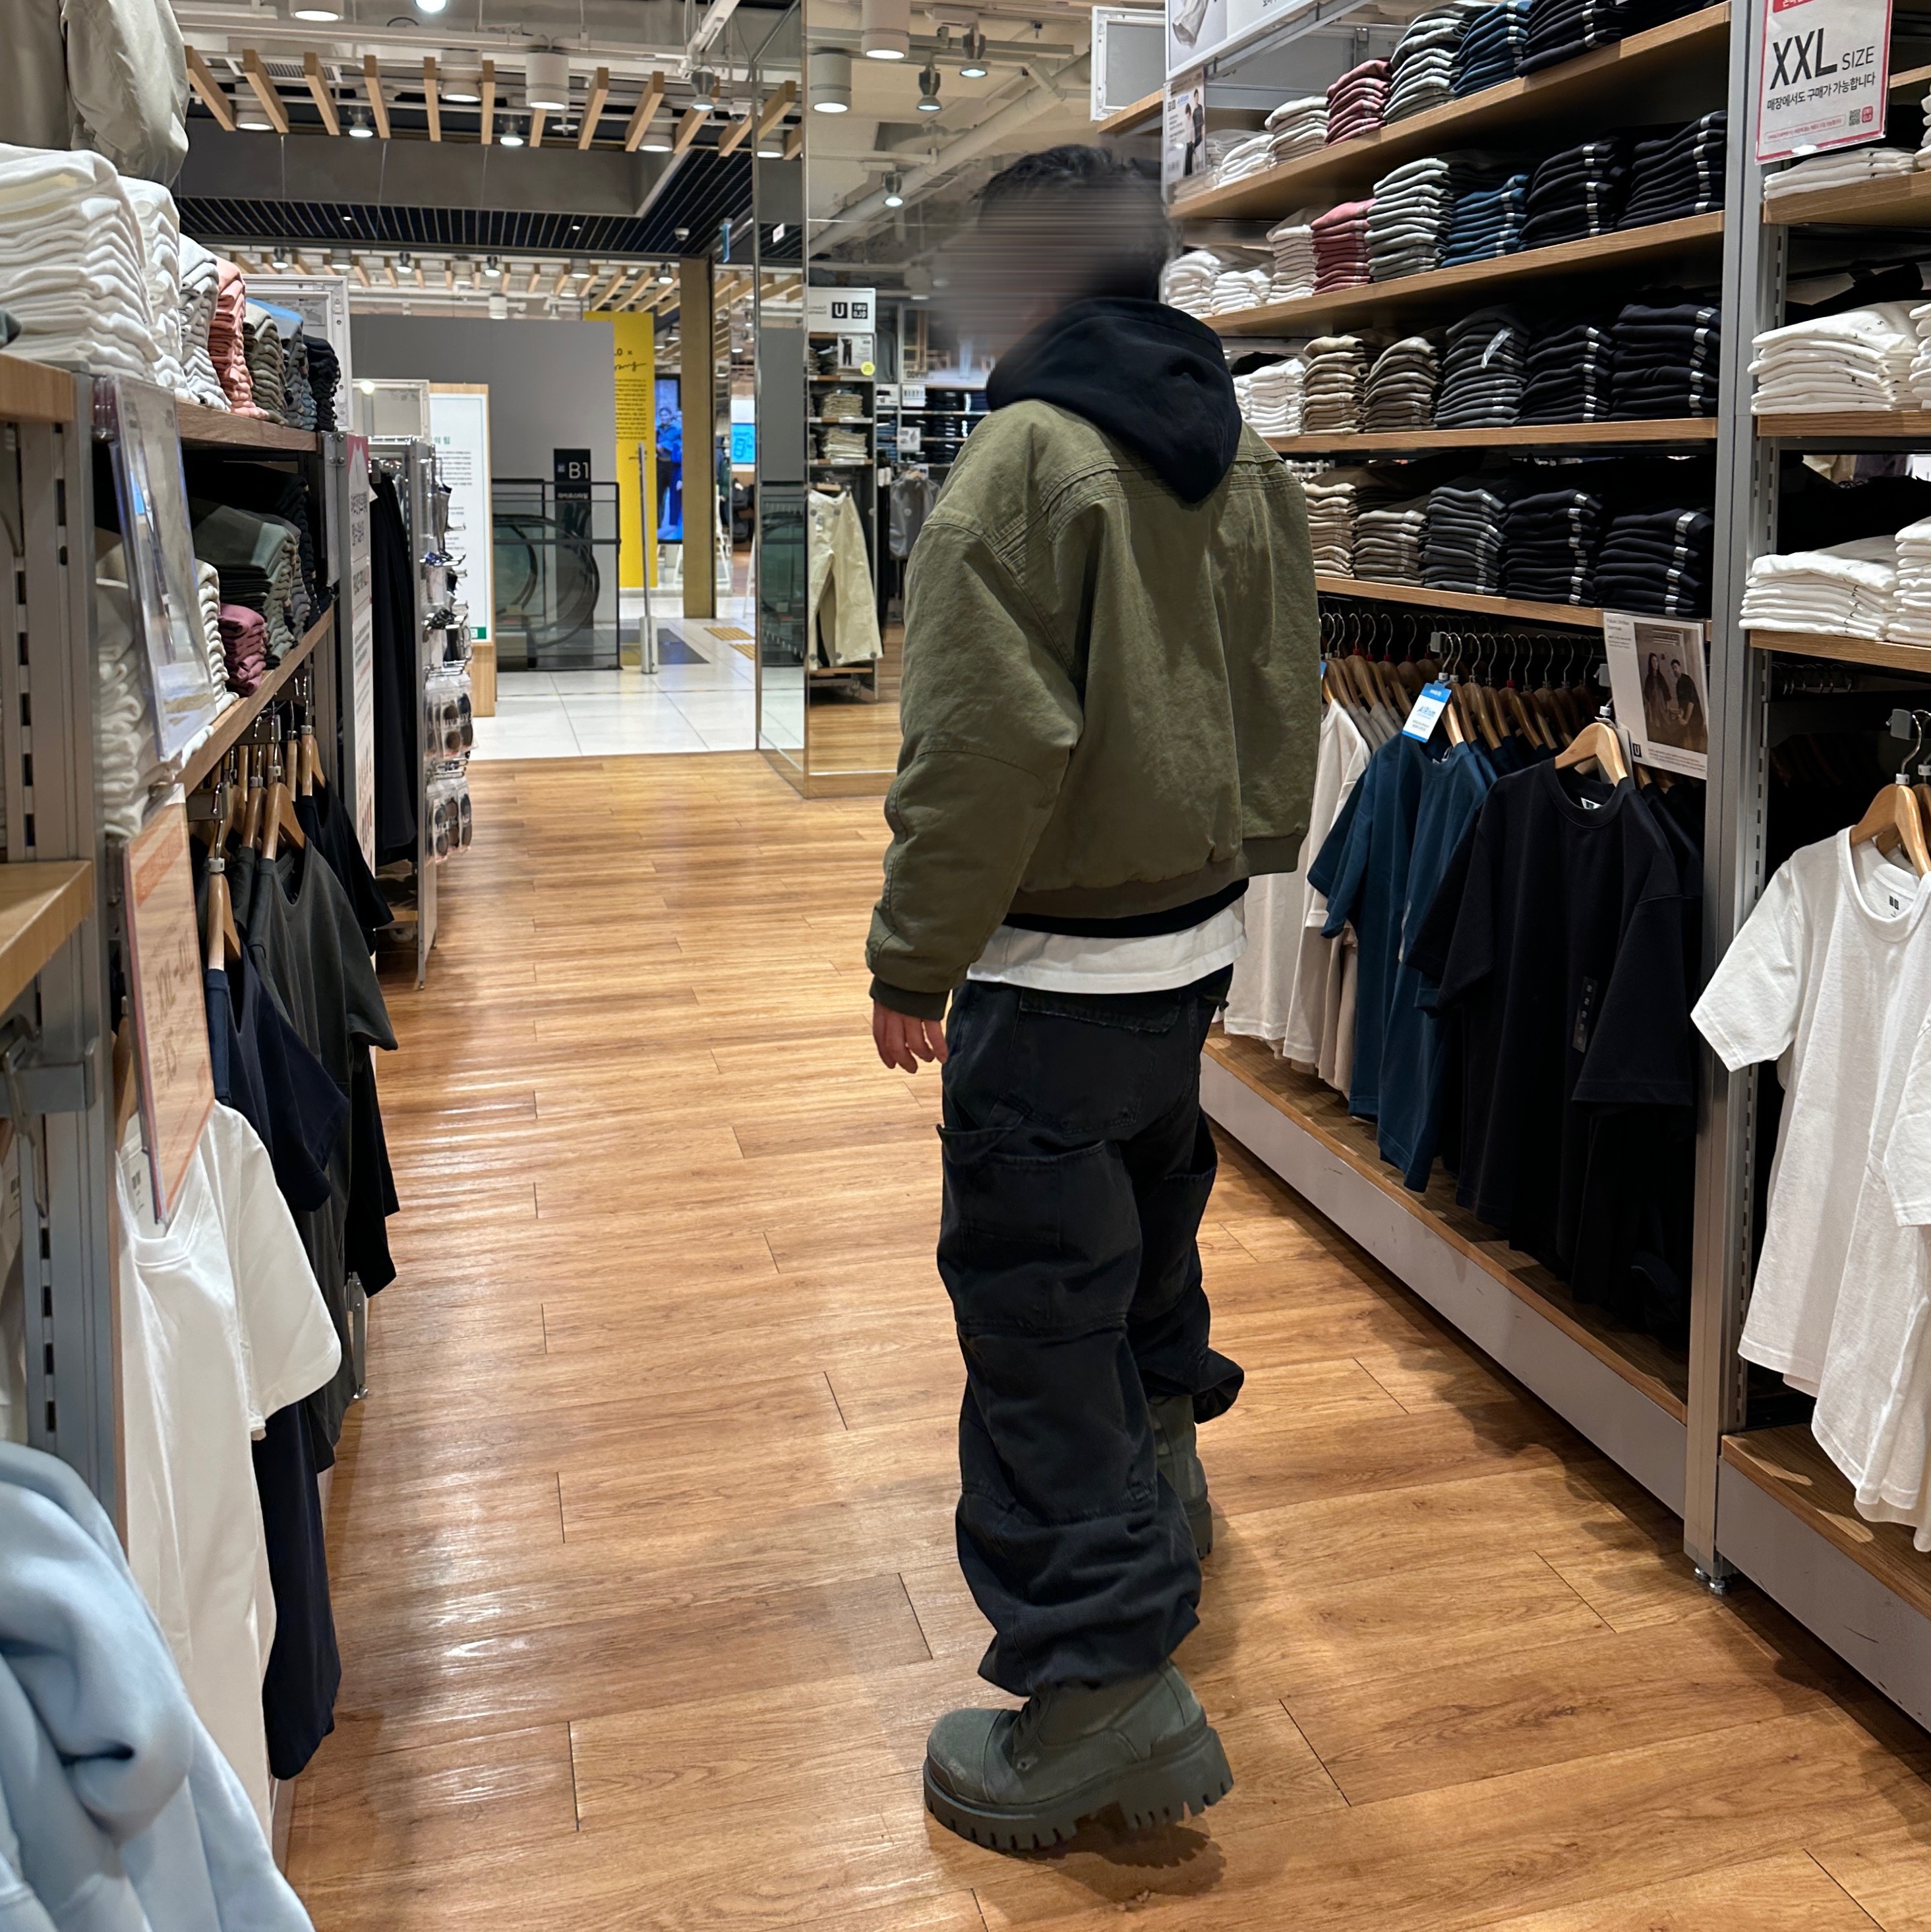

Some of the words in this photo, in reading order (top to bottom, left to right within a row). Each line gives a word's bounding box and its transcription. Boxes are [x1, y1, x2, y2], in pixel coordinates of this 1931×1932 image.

[1769, 28, 1837, 90] XXL
[1842, 45, 1875, 71] SIZE
[1767, 91, 1806, 110] 매장에서도
[1807, 84, 1831, 102] 구매가
[1833, 72, 1876, 94] 가능합니다
[569, 461, 589, 479] B1
